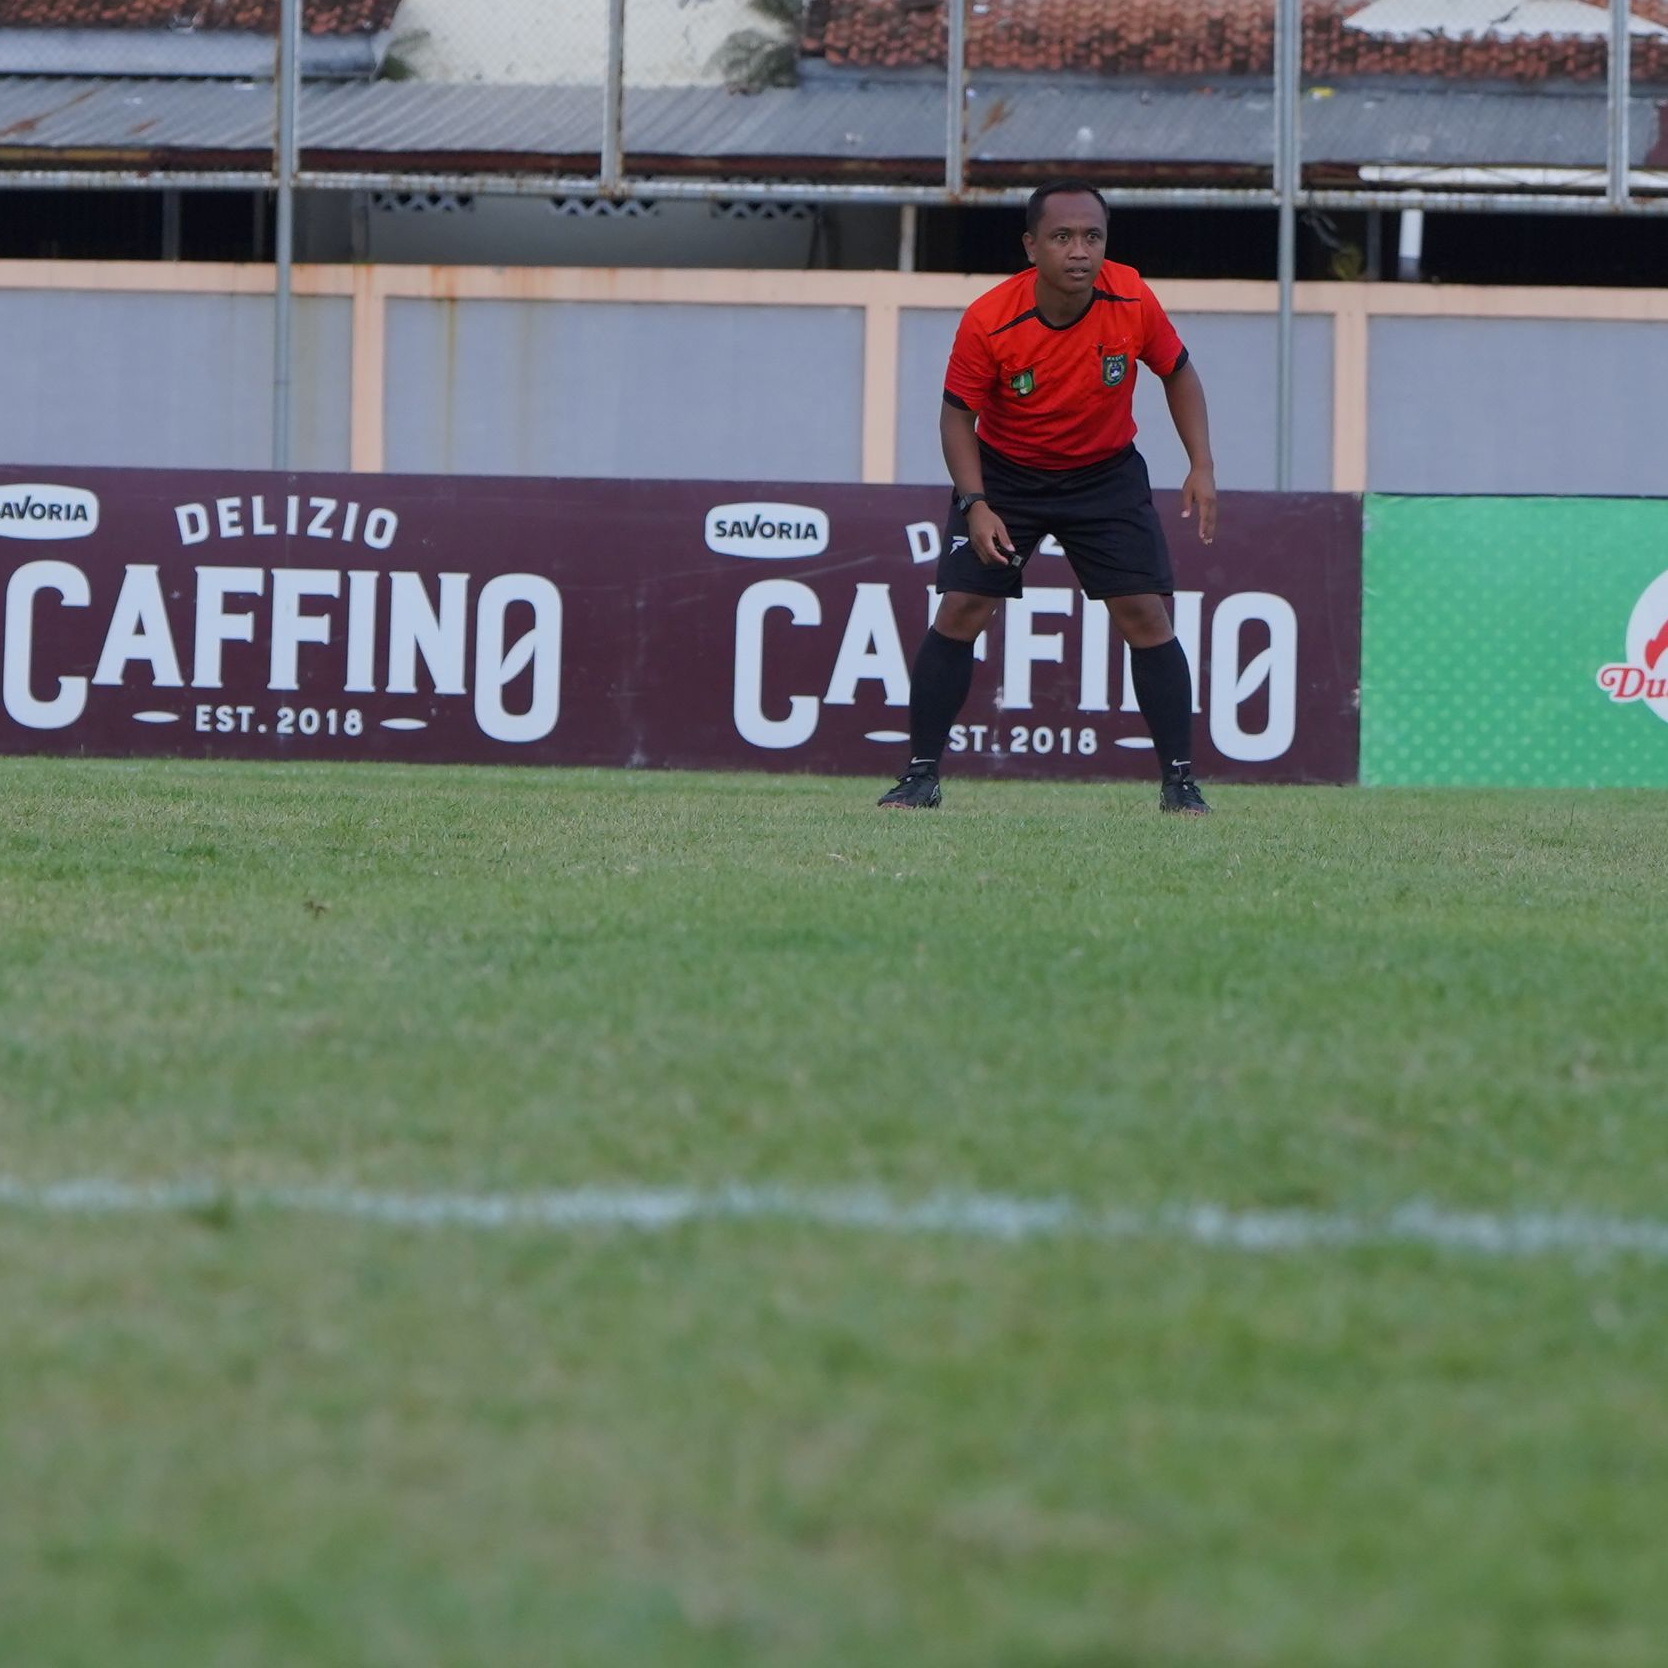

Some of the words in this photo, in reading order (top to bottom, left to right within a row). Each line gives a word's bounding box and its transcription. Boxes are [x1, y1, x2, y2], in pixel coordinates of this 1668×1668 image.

[174, 495, 399, 550] DELIZIO
[714, 512, 819, 541] SAVORIA
[2, 559, 563, 743] CAFFINO
[195, 704, 267, 734] EST.
[276, 707, 364, 736] 2018
[948, 724, 1001, 754] ST.
[1010, 726, 1098, 756] 2018
